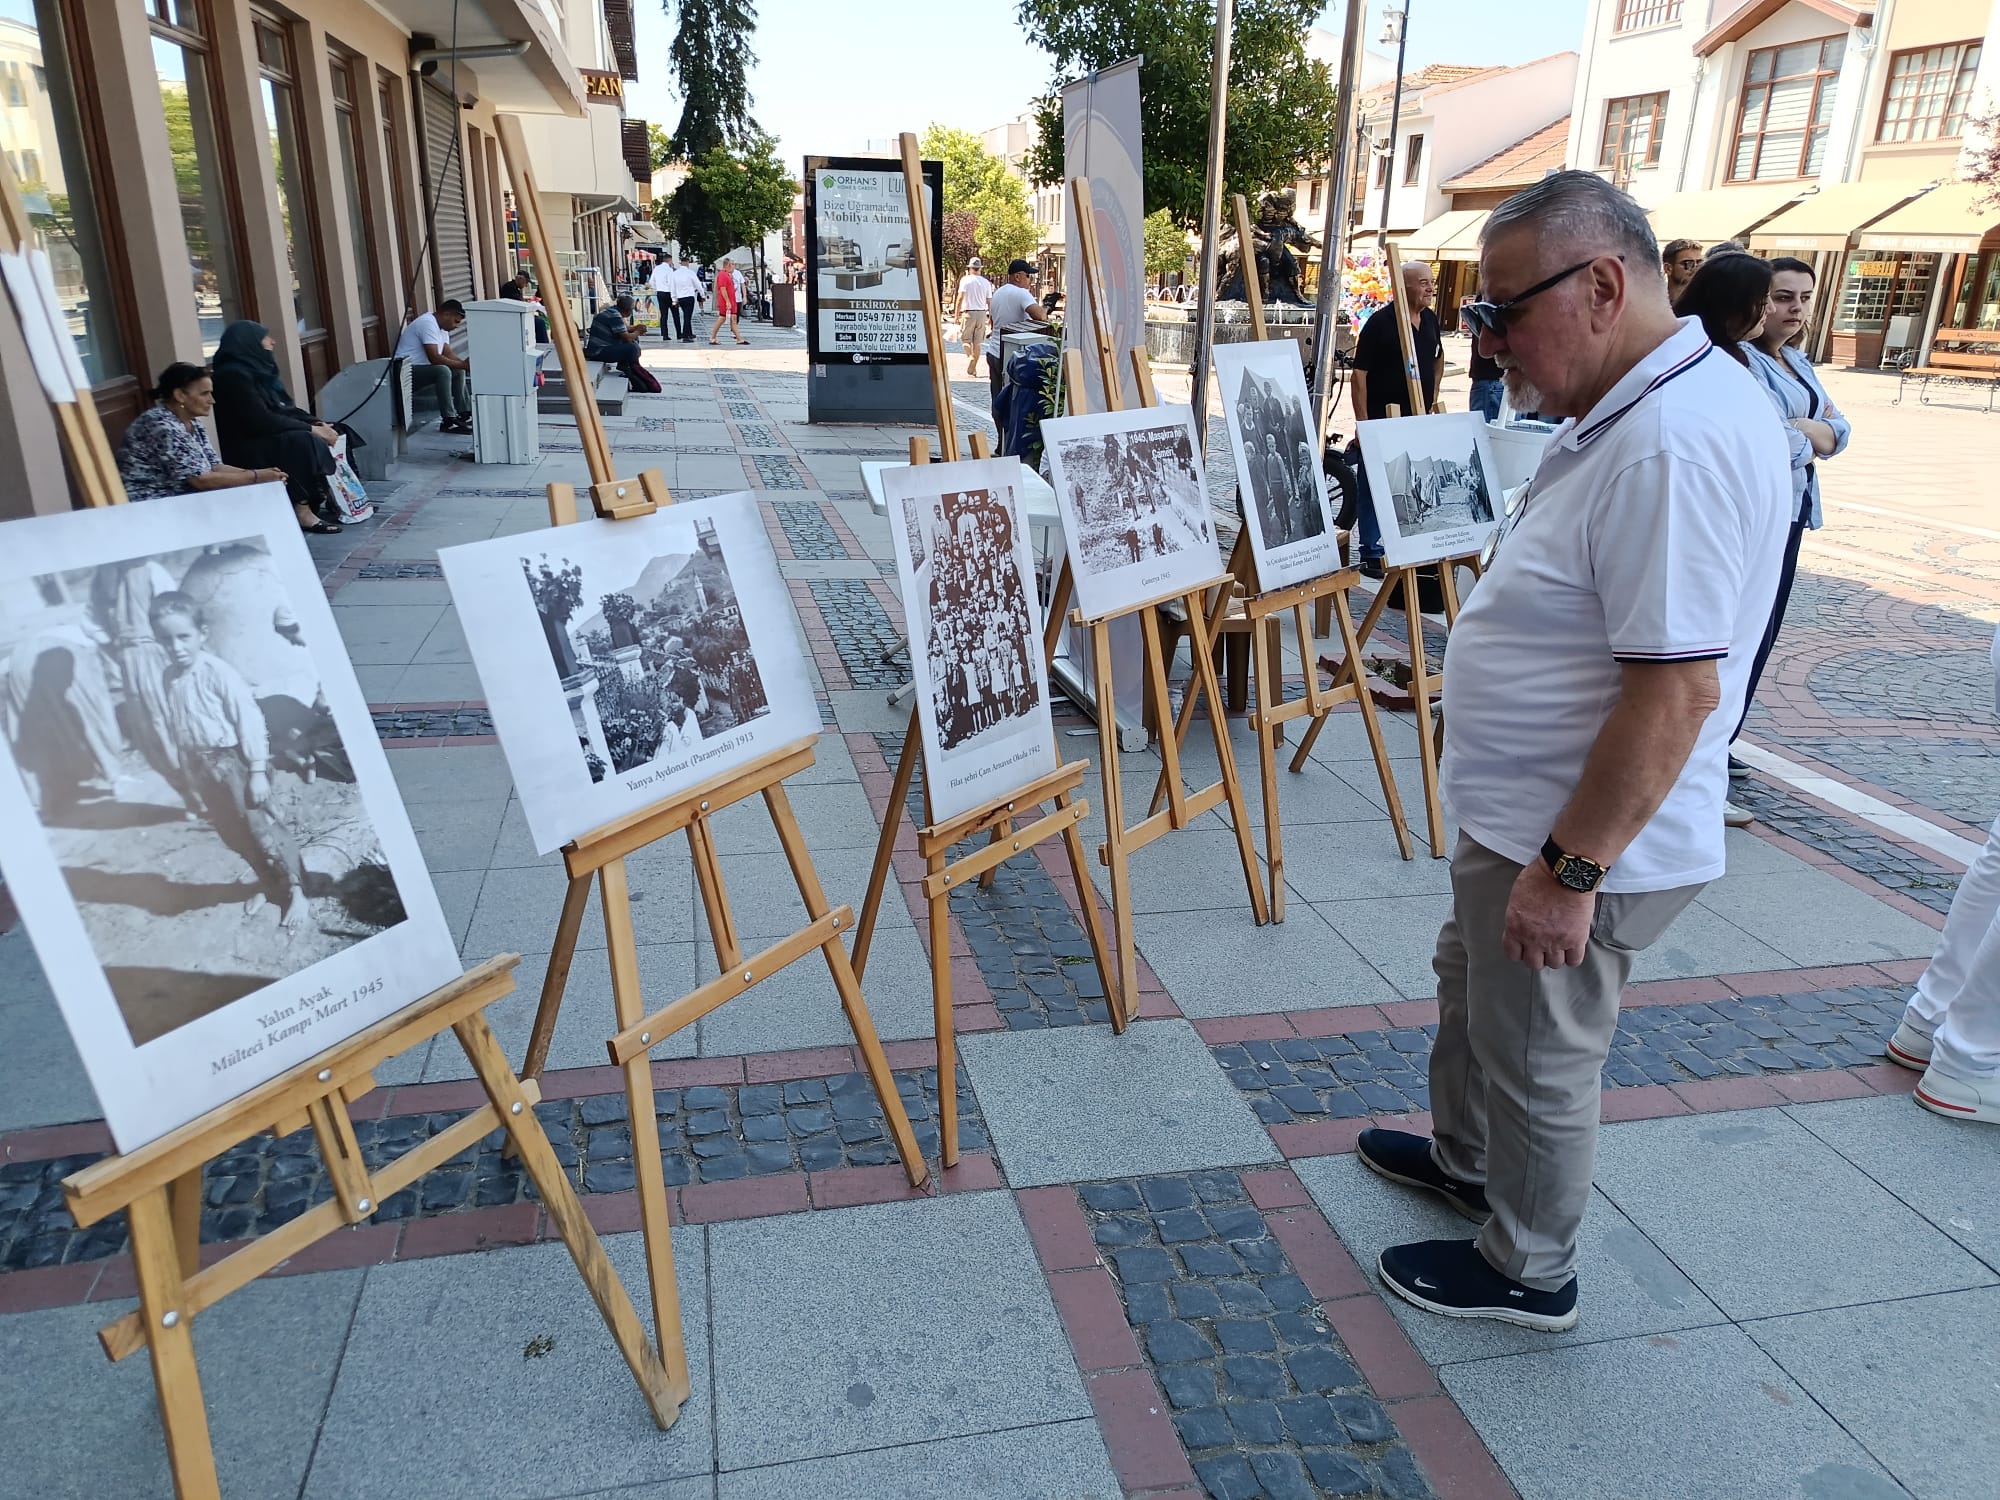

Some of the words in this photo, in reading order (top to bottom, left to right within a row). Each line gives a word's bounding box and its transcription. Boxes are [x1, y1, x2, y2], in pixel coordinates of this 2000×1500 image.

[837, 176, 877, 185] ORHAN'S
[824, 200, 845, 210] Bize
[847, 201, 899, 213] Uğramadan
[824, 211, 868, 225] Mobilya
[872, 214, 910, 224] Alınma
[849, 299, 899, 310] TEKİRDAĞ
[858, 312, 879, 322] 0549
[881, 313, 895, 321] 767
[897, 313, 905, 322] 71
[907, 313, 917, 322] 32
[835, 323, 867, 331] Hayrabolu
[869, 323, 882, 331] Yolu
[858, 333, 878, 342] 0507
[880, 333, 893, 342] 227
[896, 333, 905, 342] 38
[907, 333, 917, 342] 59
[864, 343, 877, 351] Yolu
[1148, 429, 1174, 442] Masakra
[626, 775, 654, 792] Yanya
[655, 760, 689, 782] Aydonat
[690, 741, 735, 767] (Paramythi)
[737, 732, 754, 746] 1913
[950, 777, 964, 788] Filat
[978, 767, 992, 778] Çam
[992, 757, 1012, 771] Arnavut
[1012, 751, 1028, 762] Okulu
[256, 1006, 295, 1029] Yalın
[299, 986, 333, 1010] Ayak
[211, 1038, 264, 1075] Mülteci
[267, 1018, 312, 1047] Kampı
[315, 998, 348, 1022] Mart
[352, 977, 384, 1002] 1945
